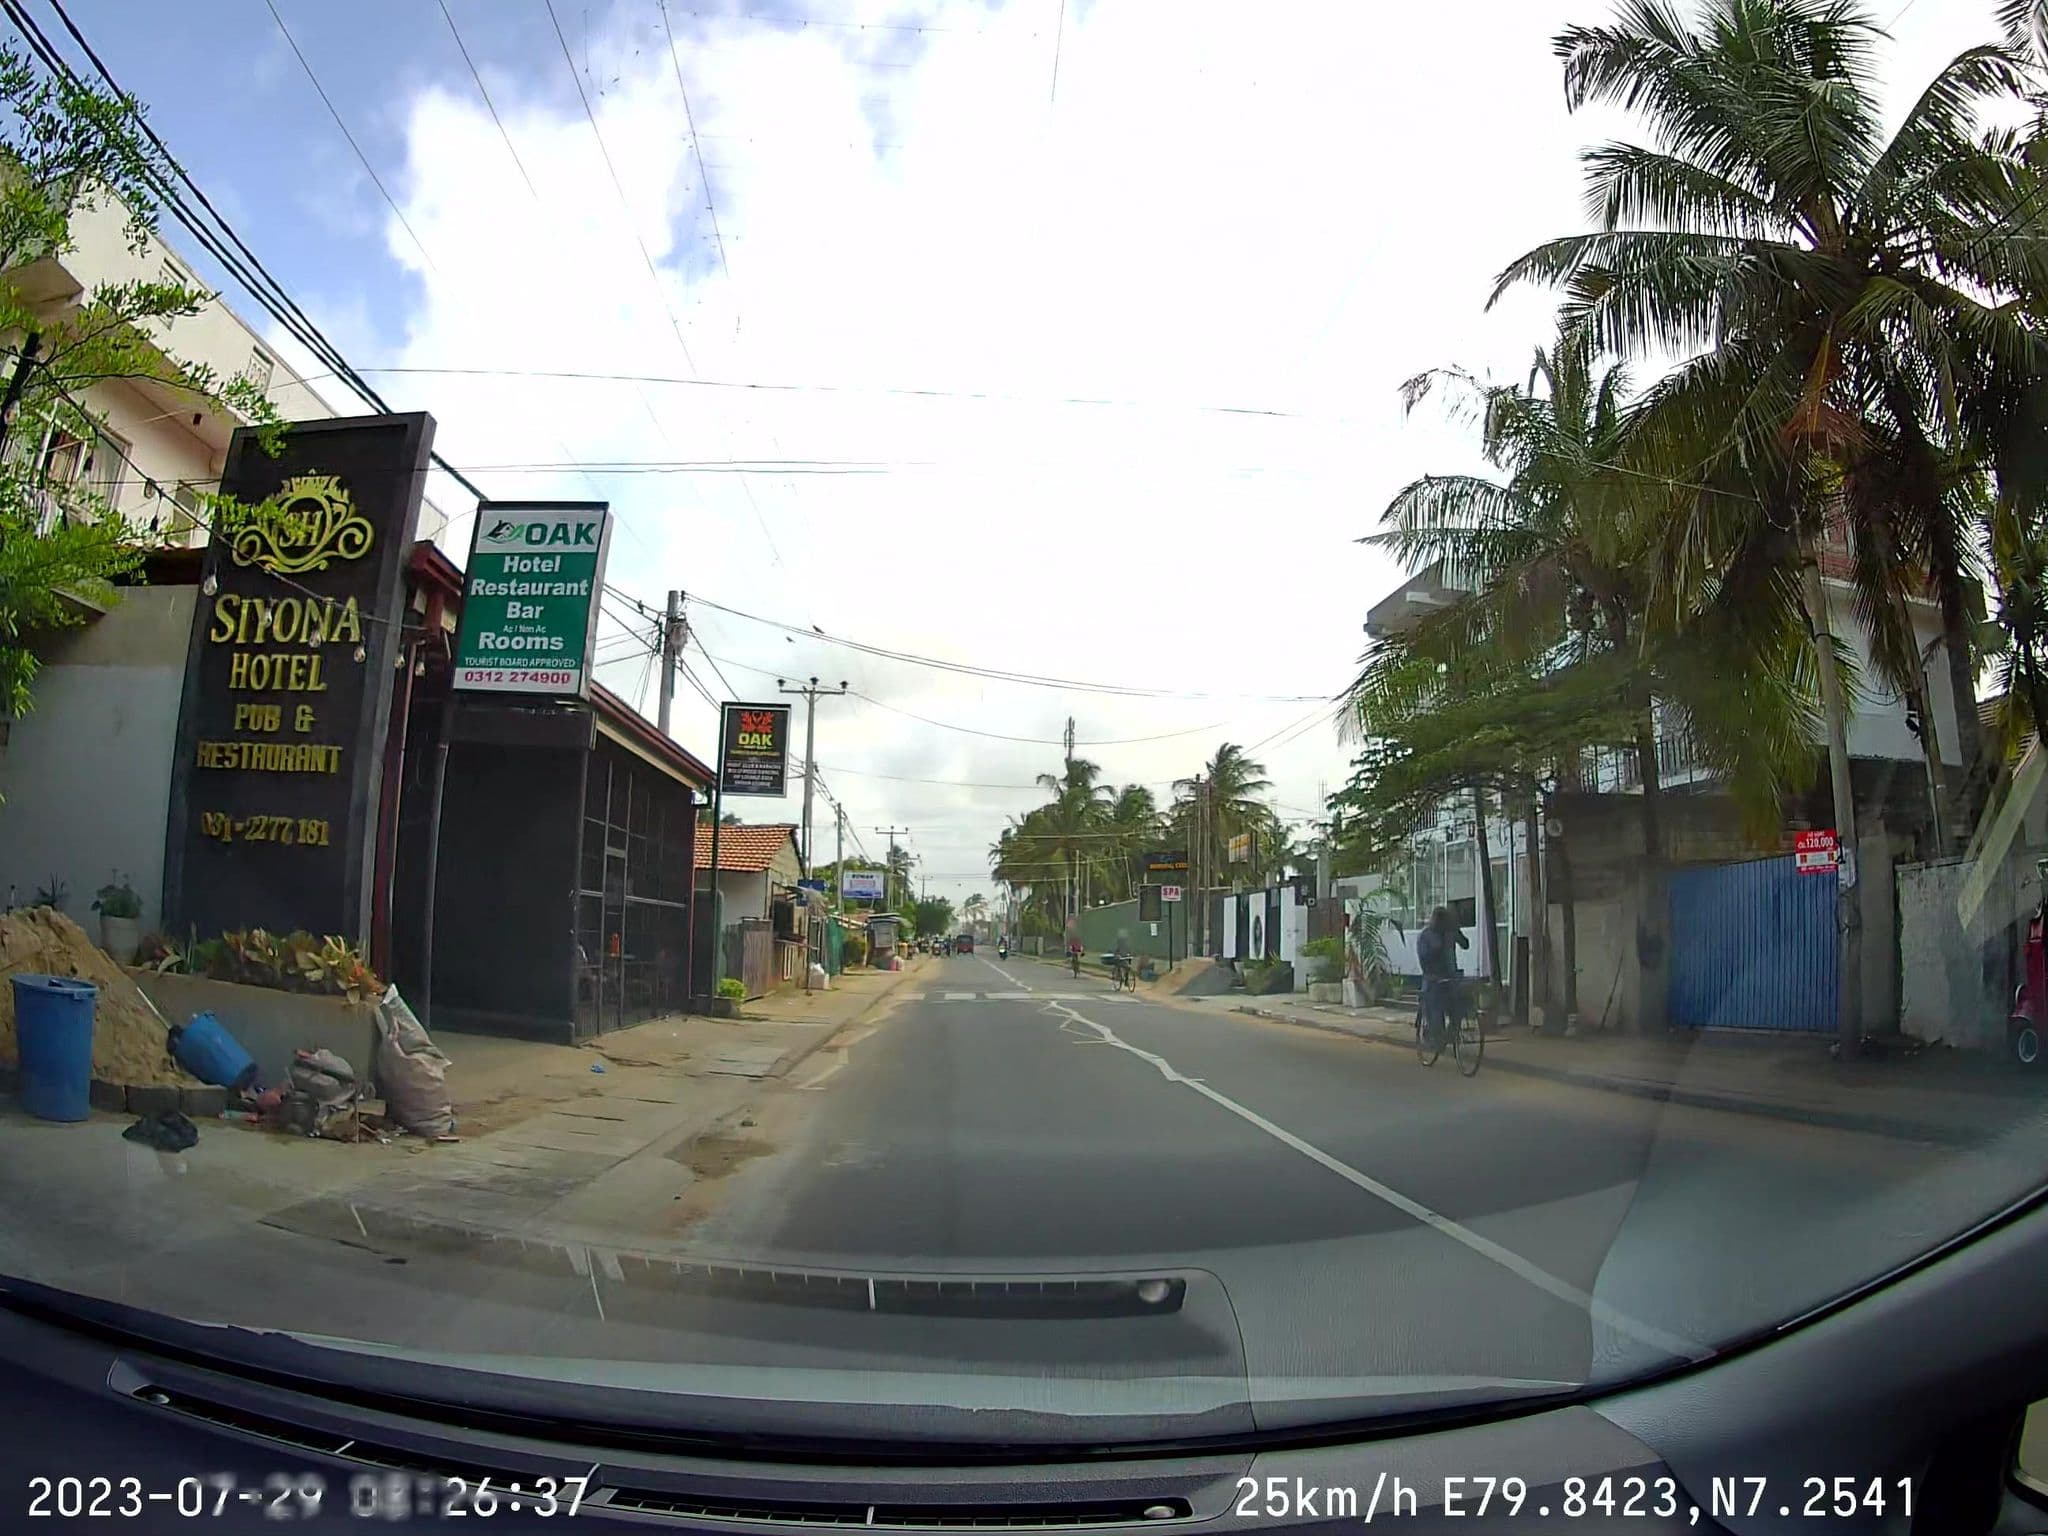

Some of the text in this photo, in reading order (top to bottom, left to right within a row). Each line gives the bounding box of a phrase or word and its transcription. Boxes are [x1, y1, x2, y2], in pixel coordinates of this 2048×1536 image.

[525, 523, 596, 546] OAK
[503, 555, 560, 573] Hotel
[471, 579, 588, 596] Restaurant
[211, 593, 361, 644] SIYONA
[506, 601, 544, 619] Bar
[478, 631, 564, 650] Rooms
[465, 657, 576, 668] TOURIST BOARD APPROVED
[229, 653, 327, 691] HOTEL
[465, 671, 571, 684] 0312 274900
[235, 703, 317, 732] PUB &
[738, 733, 773, 746] OAK
[196, 741, 342, 774] RESTAURANT
[1162, 887, 1180, 896] SPA
